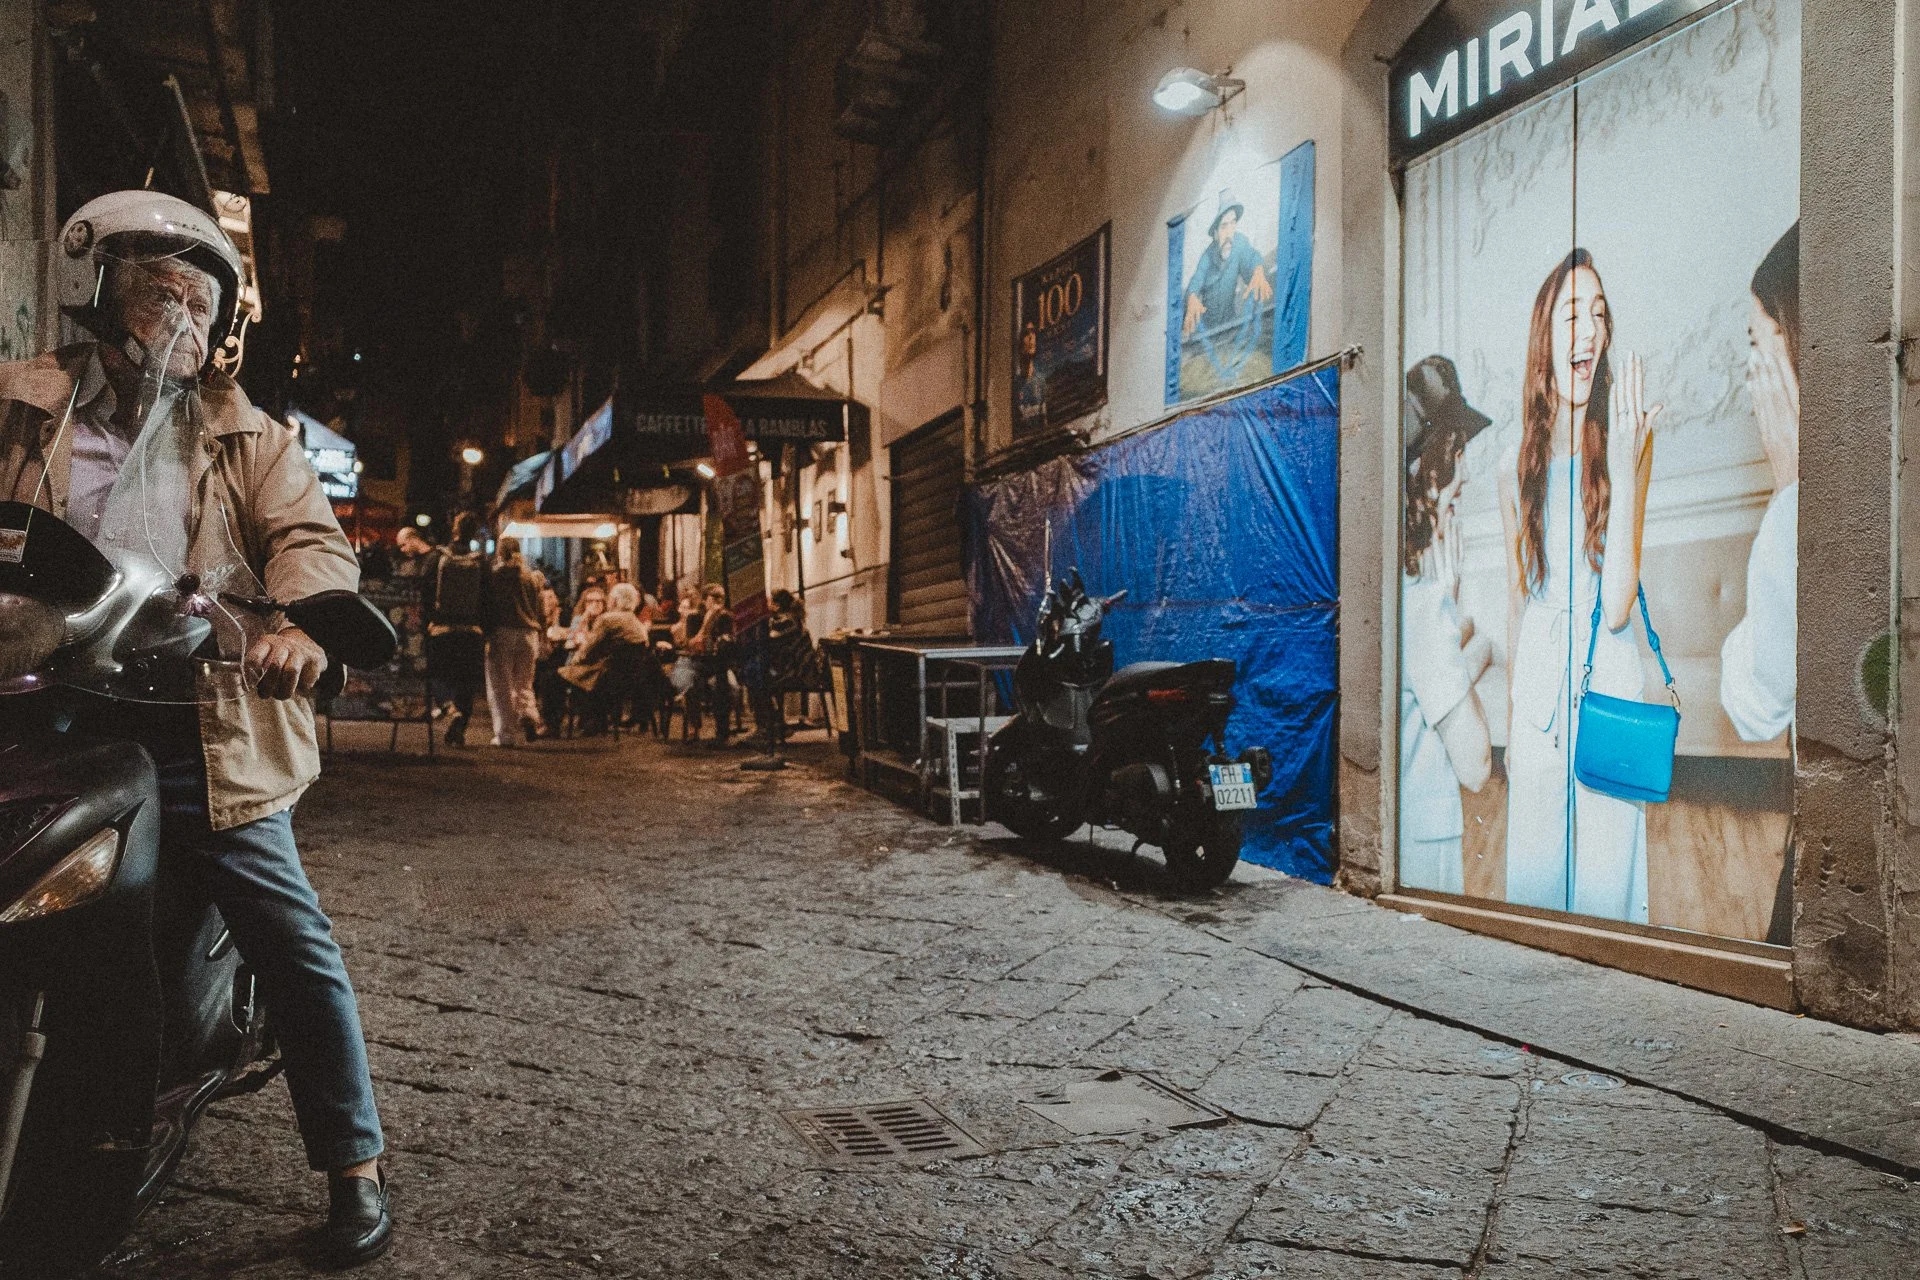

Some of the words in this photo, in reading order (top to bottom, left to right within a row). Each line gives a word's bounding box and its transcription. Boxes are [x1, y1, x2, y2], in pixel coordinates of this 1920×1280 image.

[1409, 0, 1664, 138] MIRIA
[1038, 272, 1082, 331] 100
[636, 413, 706, 435] CAFFETTE
[1217, 788, 1253, 805] 02211
